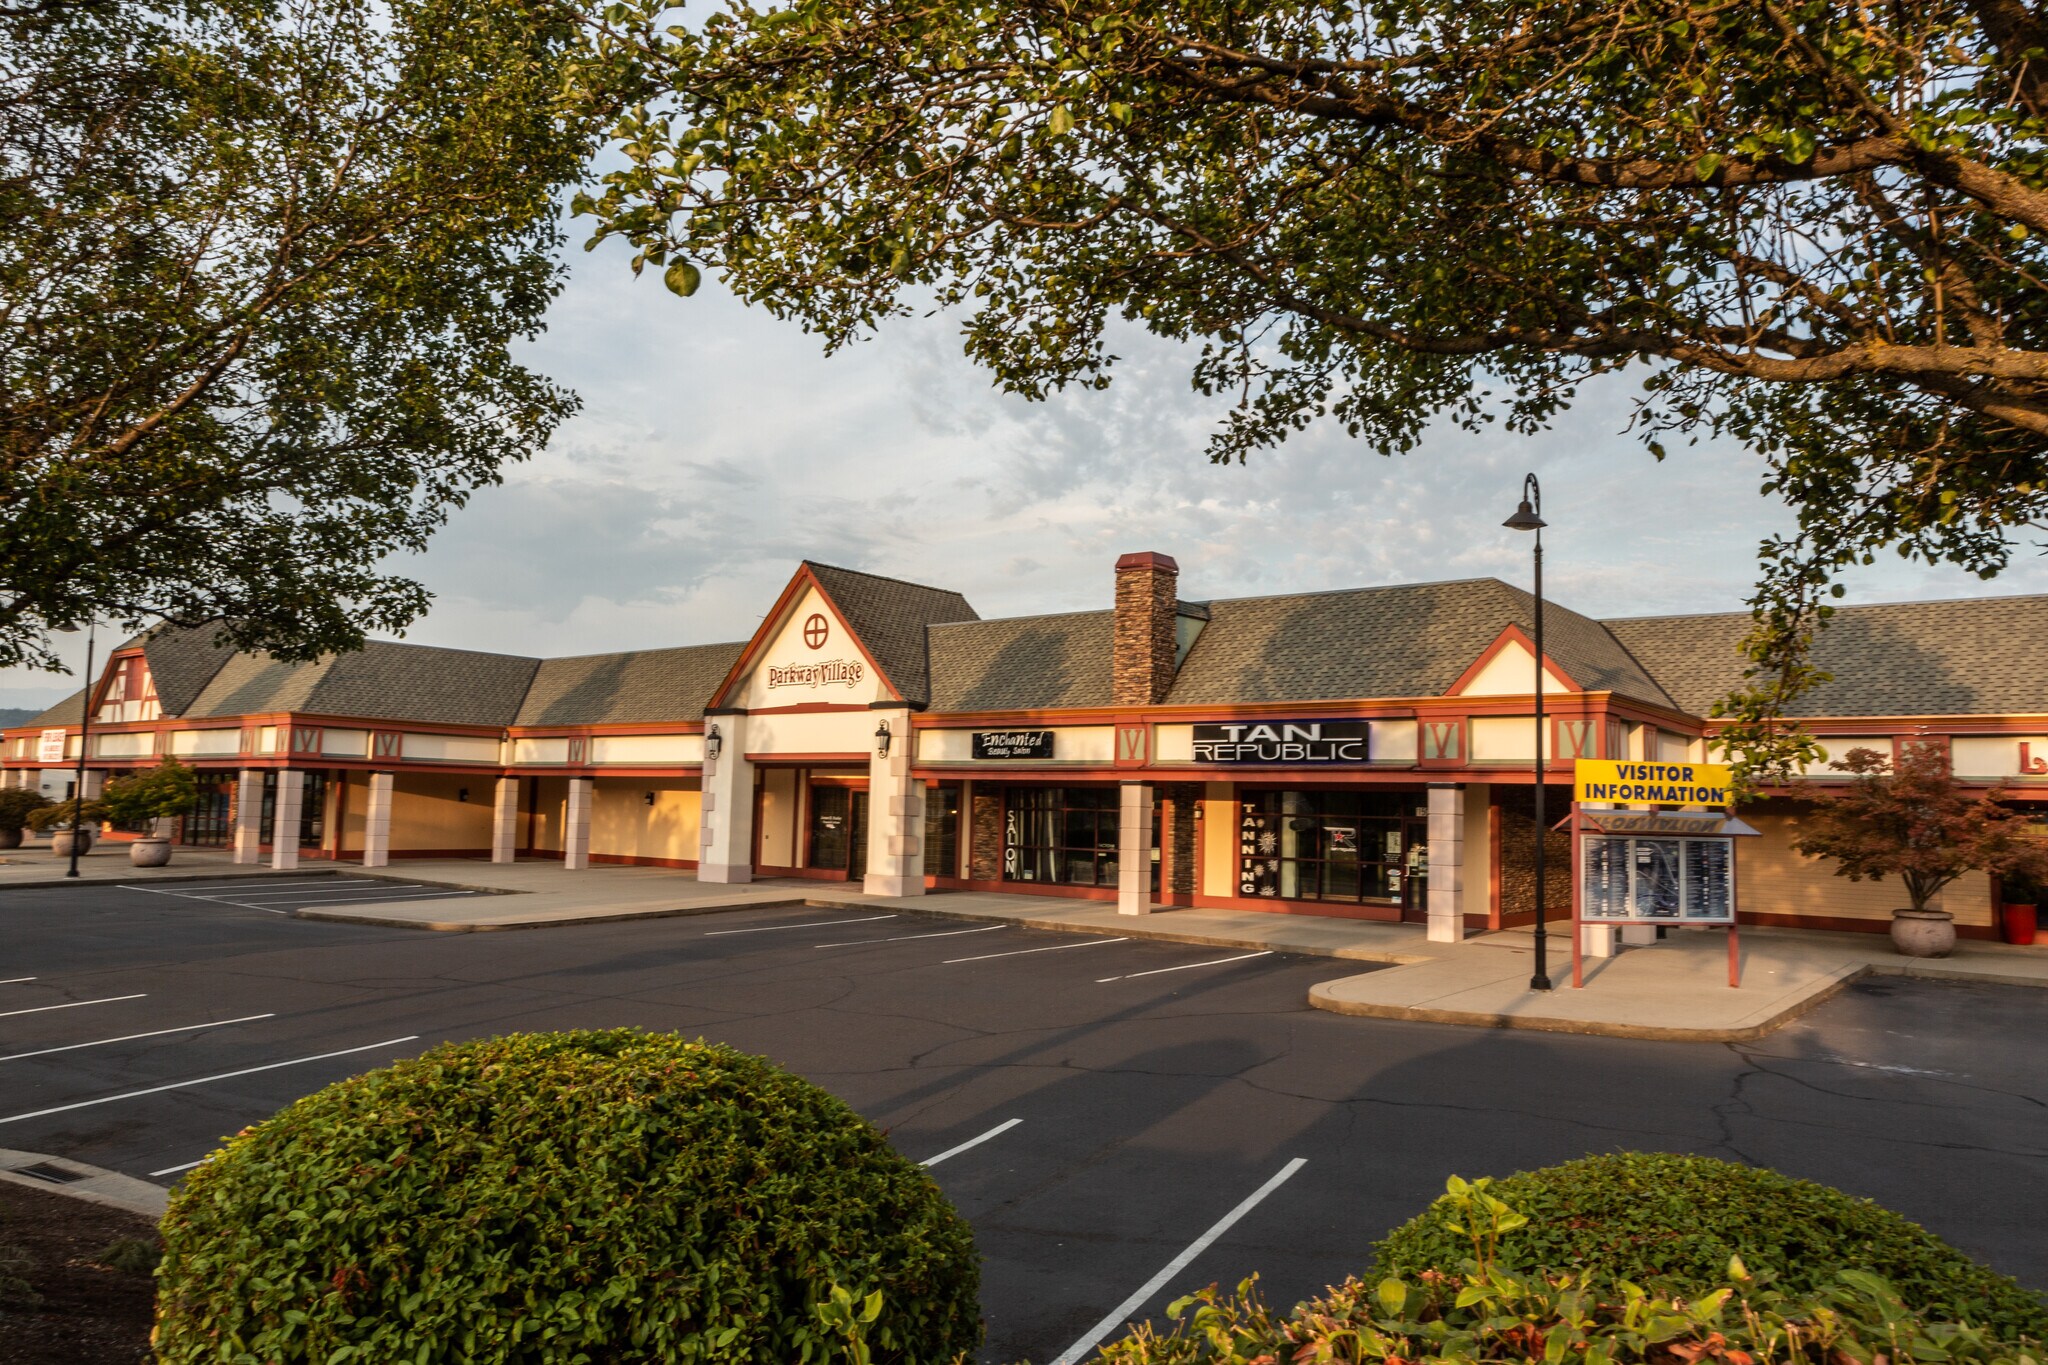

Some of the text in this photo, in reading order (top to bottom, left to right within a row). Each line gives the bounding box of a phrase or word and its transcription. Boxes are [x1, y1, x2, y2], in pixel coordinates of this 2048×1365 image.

[769, 662, 863, 687] Parkway Village
[981, 731, 1045, 747] Enchanted
[1221, 724, 1321, 742] TAN
[1193, 743, 1363, 761] REPUBLIC
[1616, 764, 1693, 782] VISITOR
[1585, 783, 1725, 802] INFORMATION
[1005, 810, 1016, 873] SALON
[1242, 804, 1256, 893] TANNING
